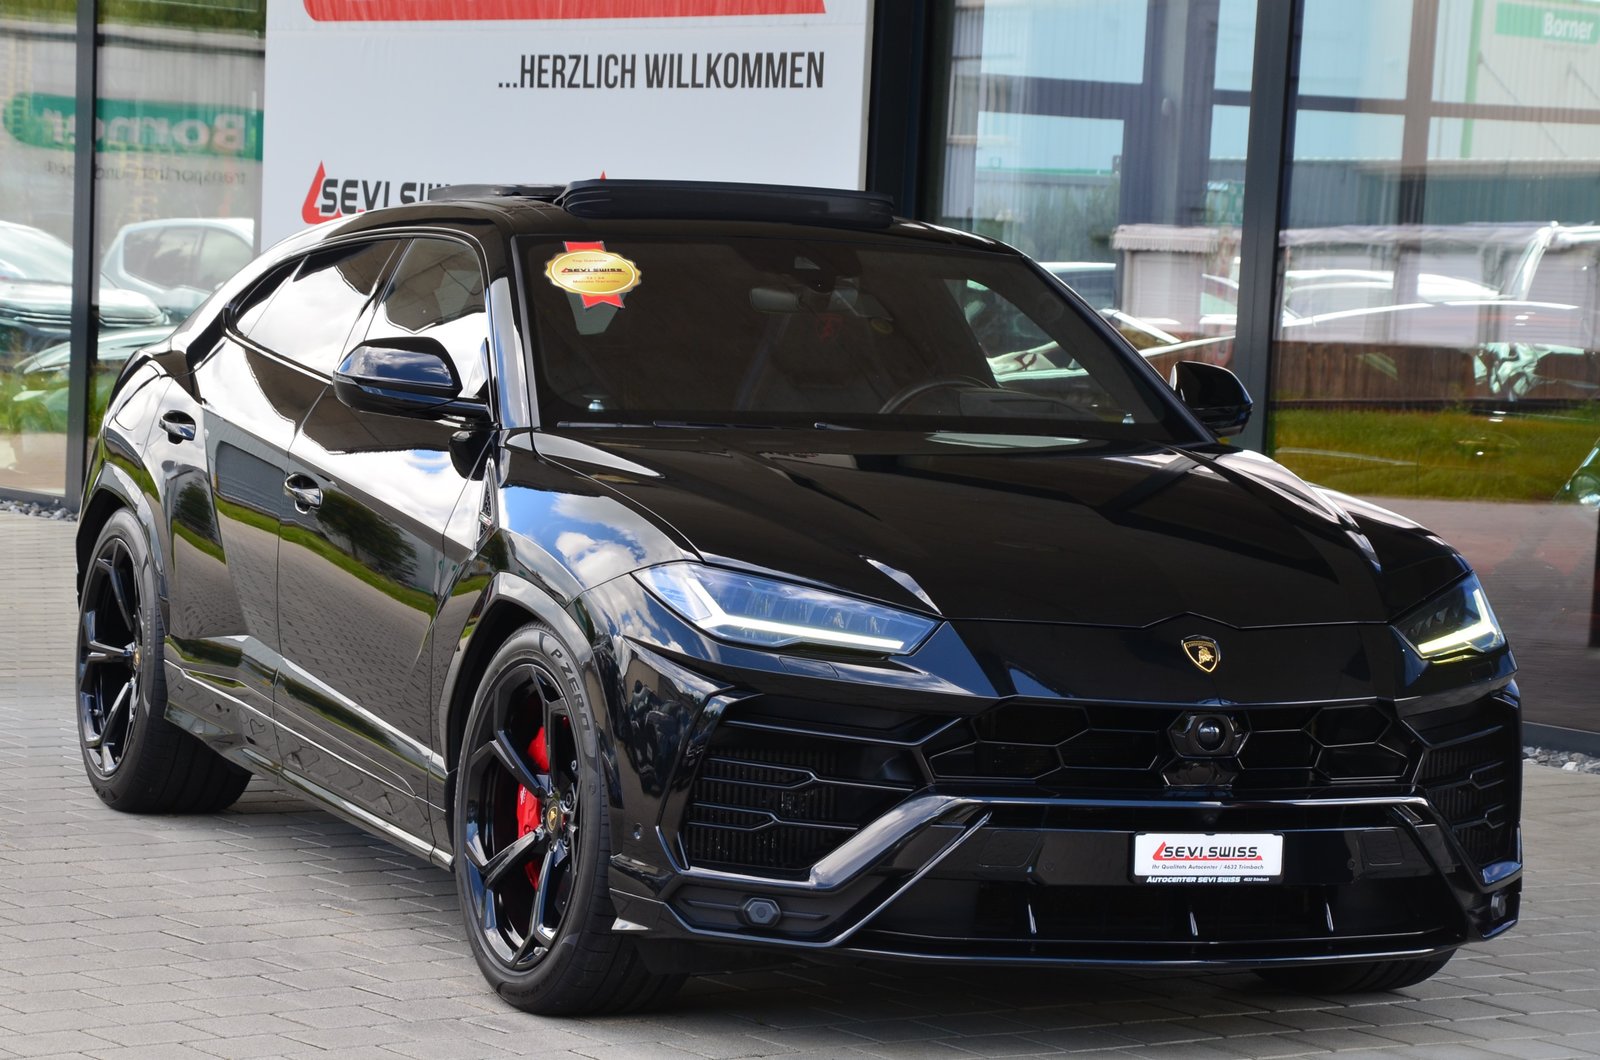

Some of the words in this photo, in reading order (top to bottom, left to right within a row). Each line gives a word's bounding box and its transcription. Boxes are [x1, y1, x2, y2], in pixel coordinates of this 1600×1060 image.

[1543, 11, 1595, 40] Borner
[644, 51, 824, 89] WILLKOMMEN
[320, 178, 391, 214] SEVI
[560, 662, 591, 731] ZERO
[1163, 846, 1204, 858] SEVI
[1208, 846, 1258, 858] SWISS
